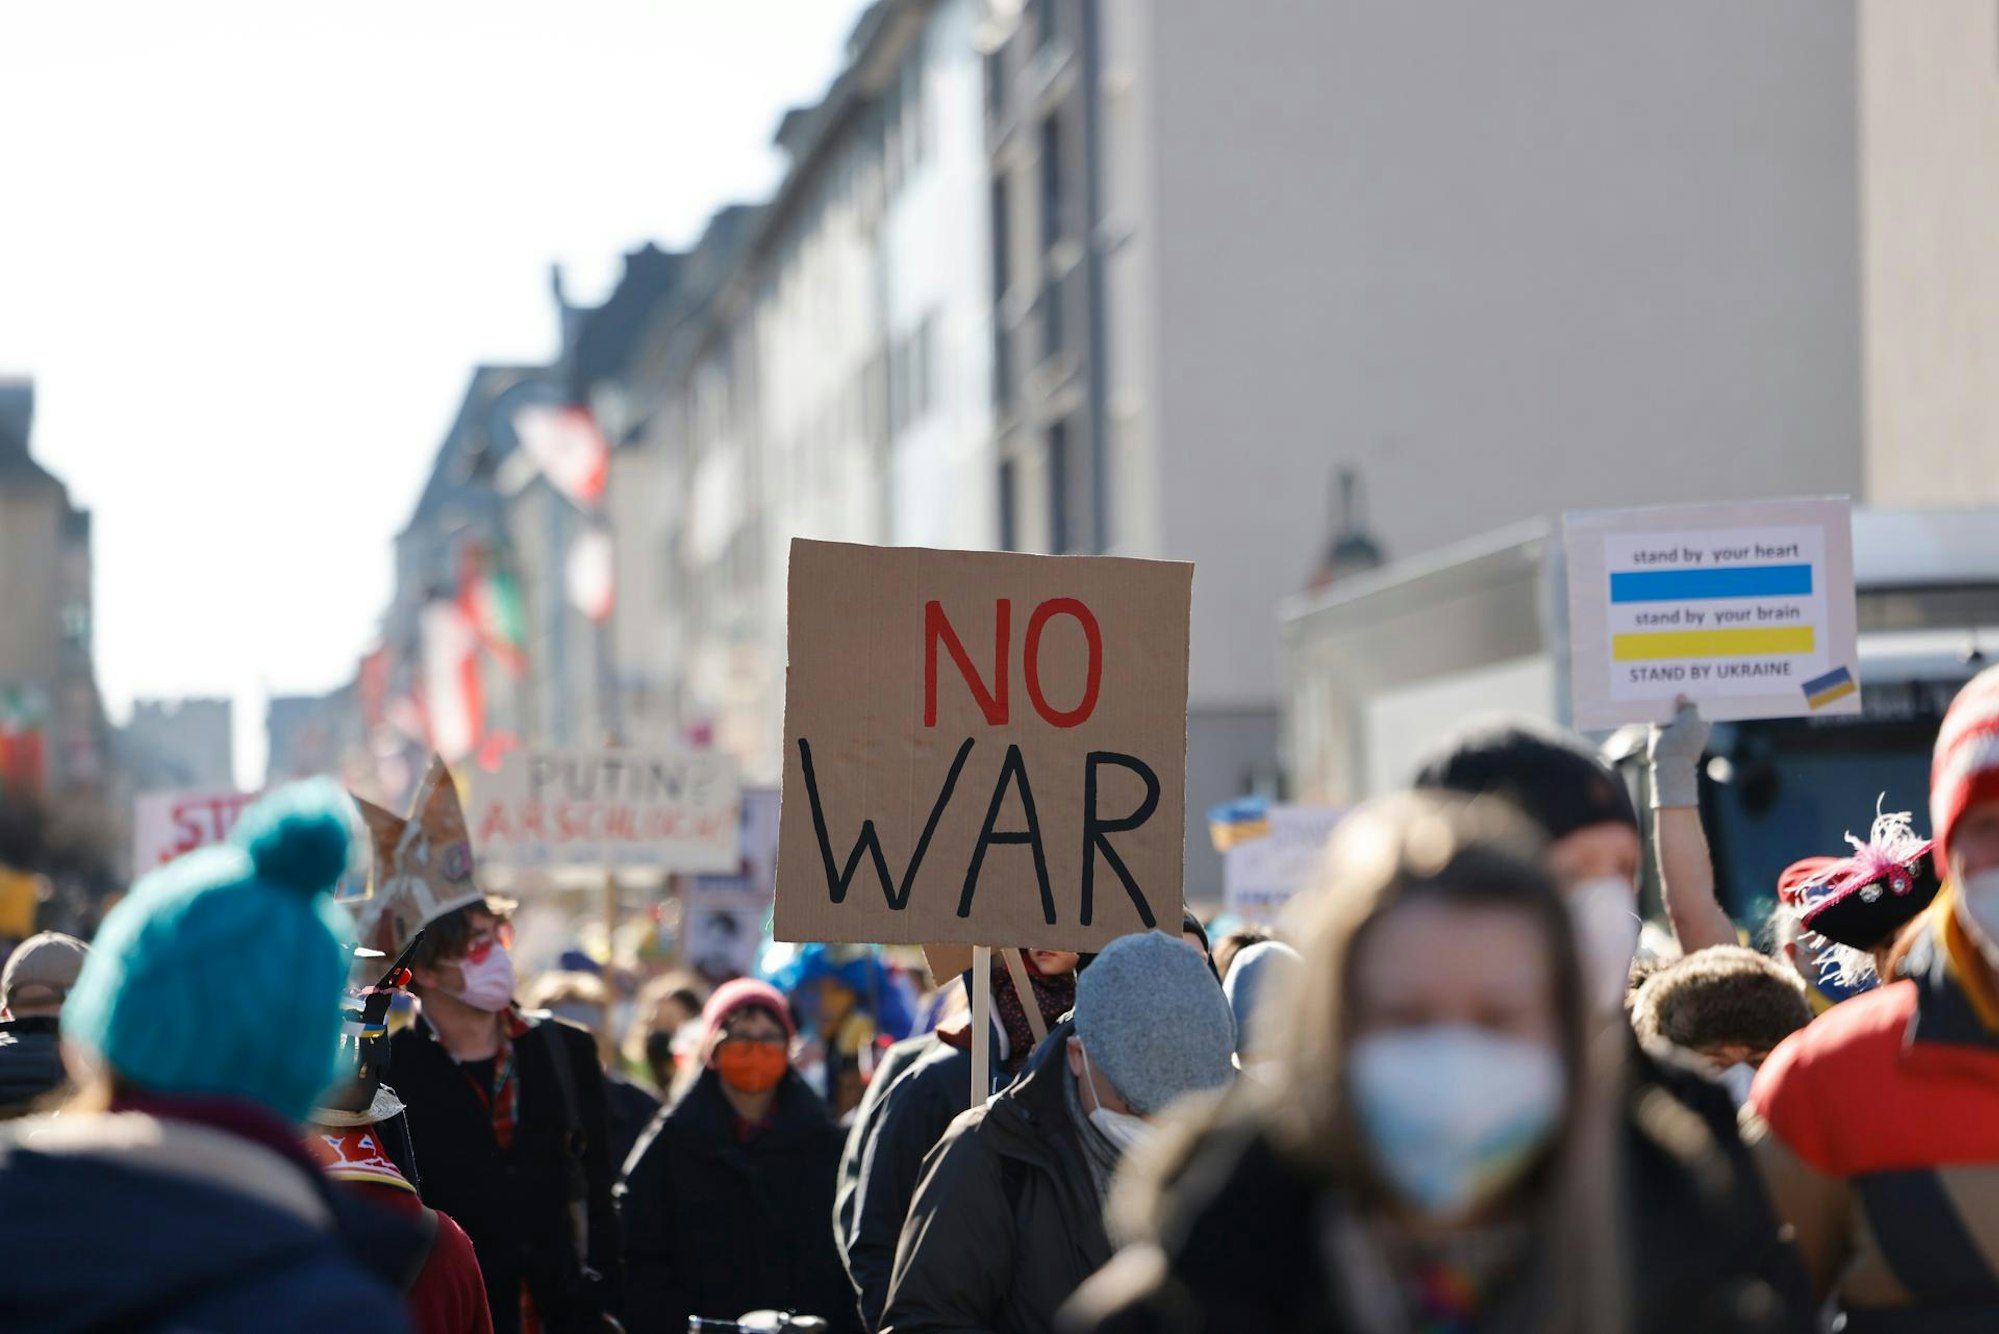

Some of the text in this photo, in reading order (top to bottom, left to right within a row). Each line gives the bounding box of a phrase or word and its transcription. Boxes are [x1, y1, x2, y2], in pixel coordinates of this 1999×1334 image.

[1632, 543, 1799, 565] stand by your heart
[1634, 603, 1801, 626] stand by your brain
[924, 597, 1103, 728] NO
[1629, 661, 1793, 683] STAND BY UKRAINE
[798, 737, 1161, 929] WAR
